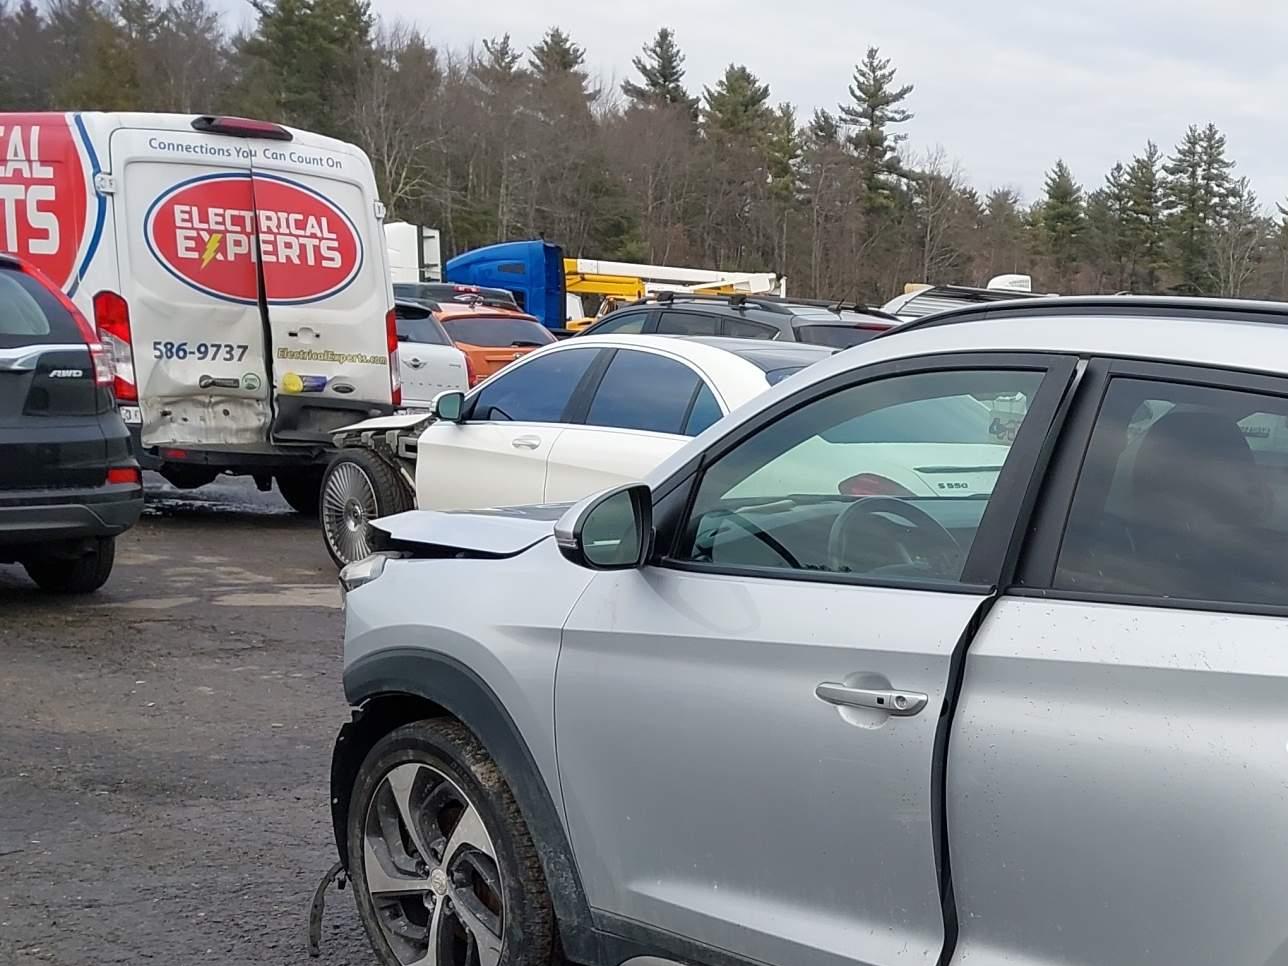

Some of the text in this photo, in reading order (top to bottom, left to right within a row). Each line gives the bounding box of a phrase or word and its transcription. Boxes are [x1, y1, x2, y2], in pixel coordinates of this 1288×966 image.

[149, 137, 342, 168] Connections You Can Count On
[174, 204, 337, 239] ELECTRICAL
[175, 228, 342, 268] EXPERTS
[153, 341, 249, 362] 586-9737
[49, 369, 83, 378] AWD
